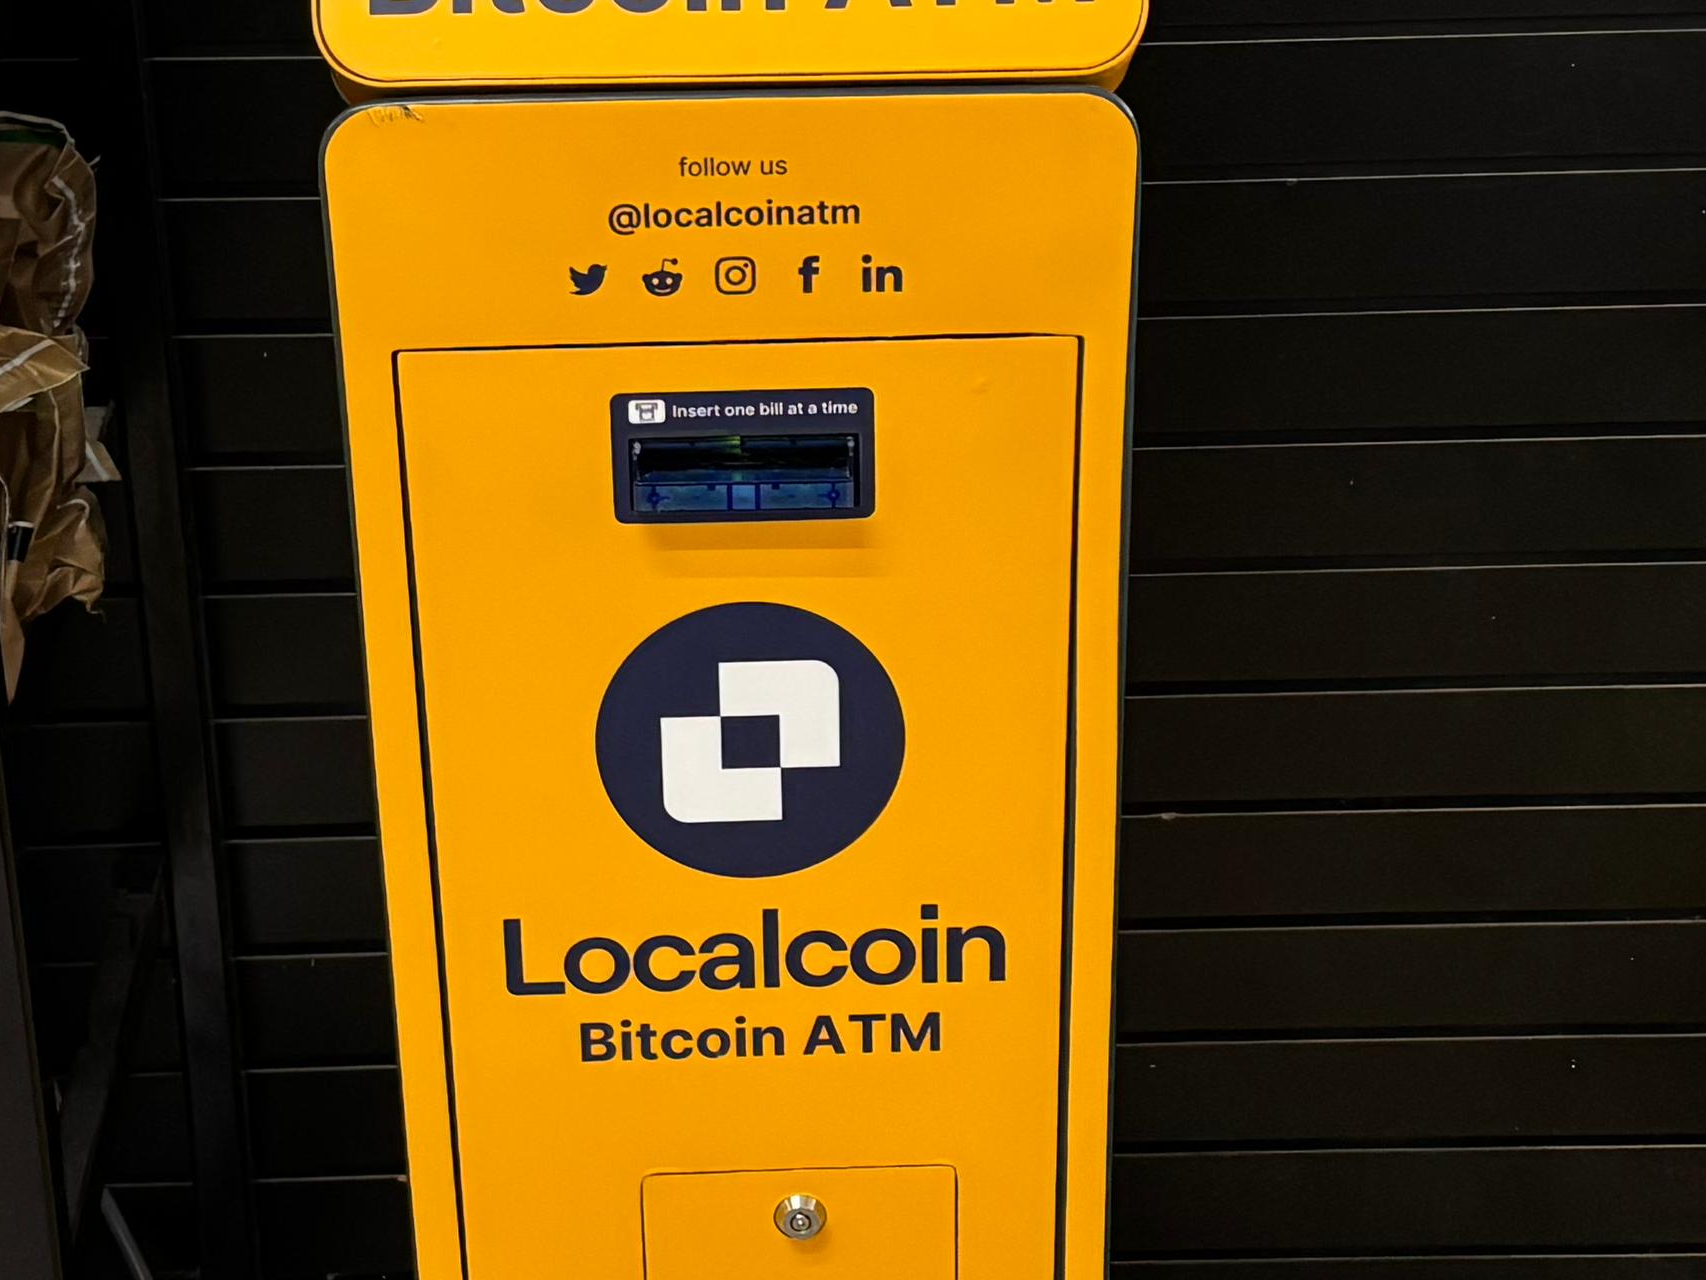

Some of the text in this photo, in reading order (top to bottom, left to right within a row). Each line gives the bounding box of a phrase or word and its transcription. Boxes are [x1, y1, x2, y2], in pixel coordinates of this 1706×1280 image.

[678, 155, 788, 177] follow us
[607, 200, 861, 237] @localcoinatm
[671, 400, 858, 418] Insert one bill at a time
[502, 904, 1007, 997] Localcoin
[578, 1011, 942, 1063] Bitcoin ATM
